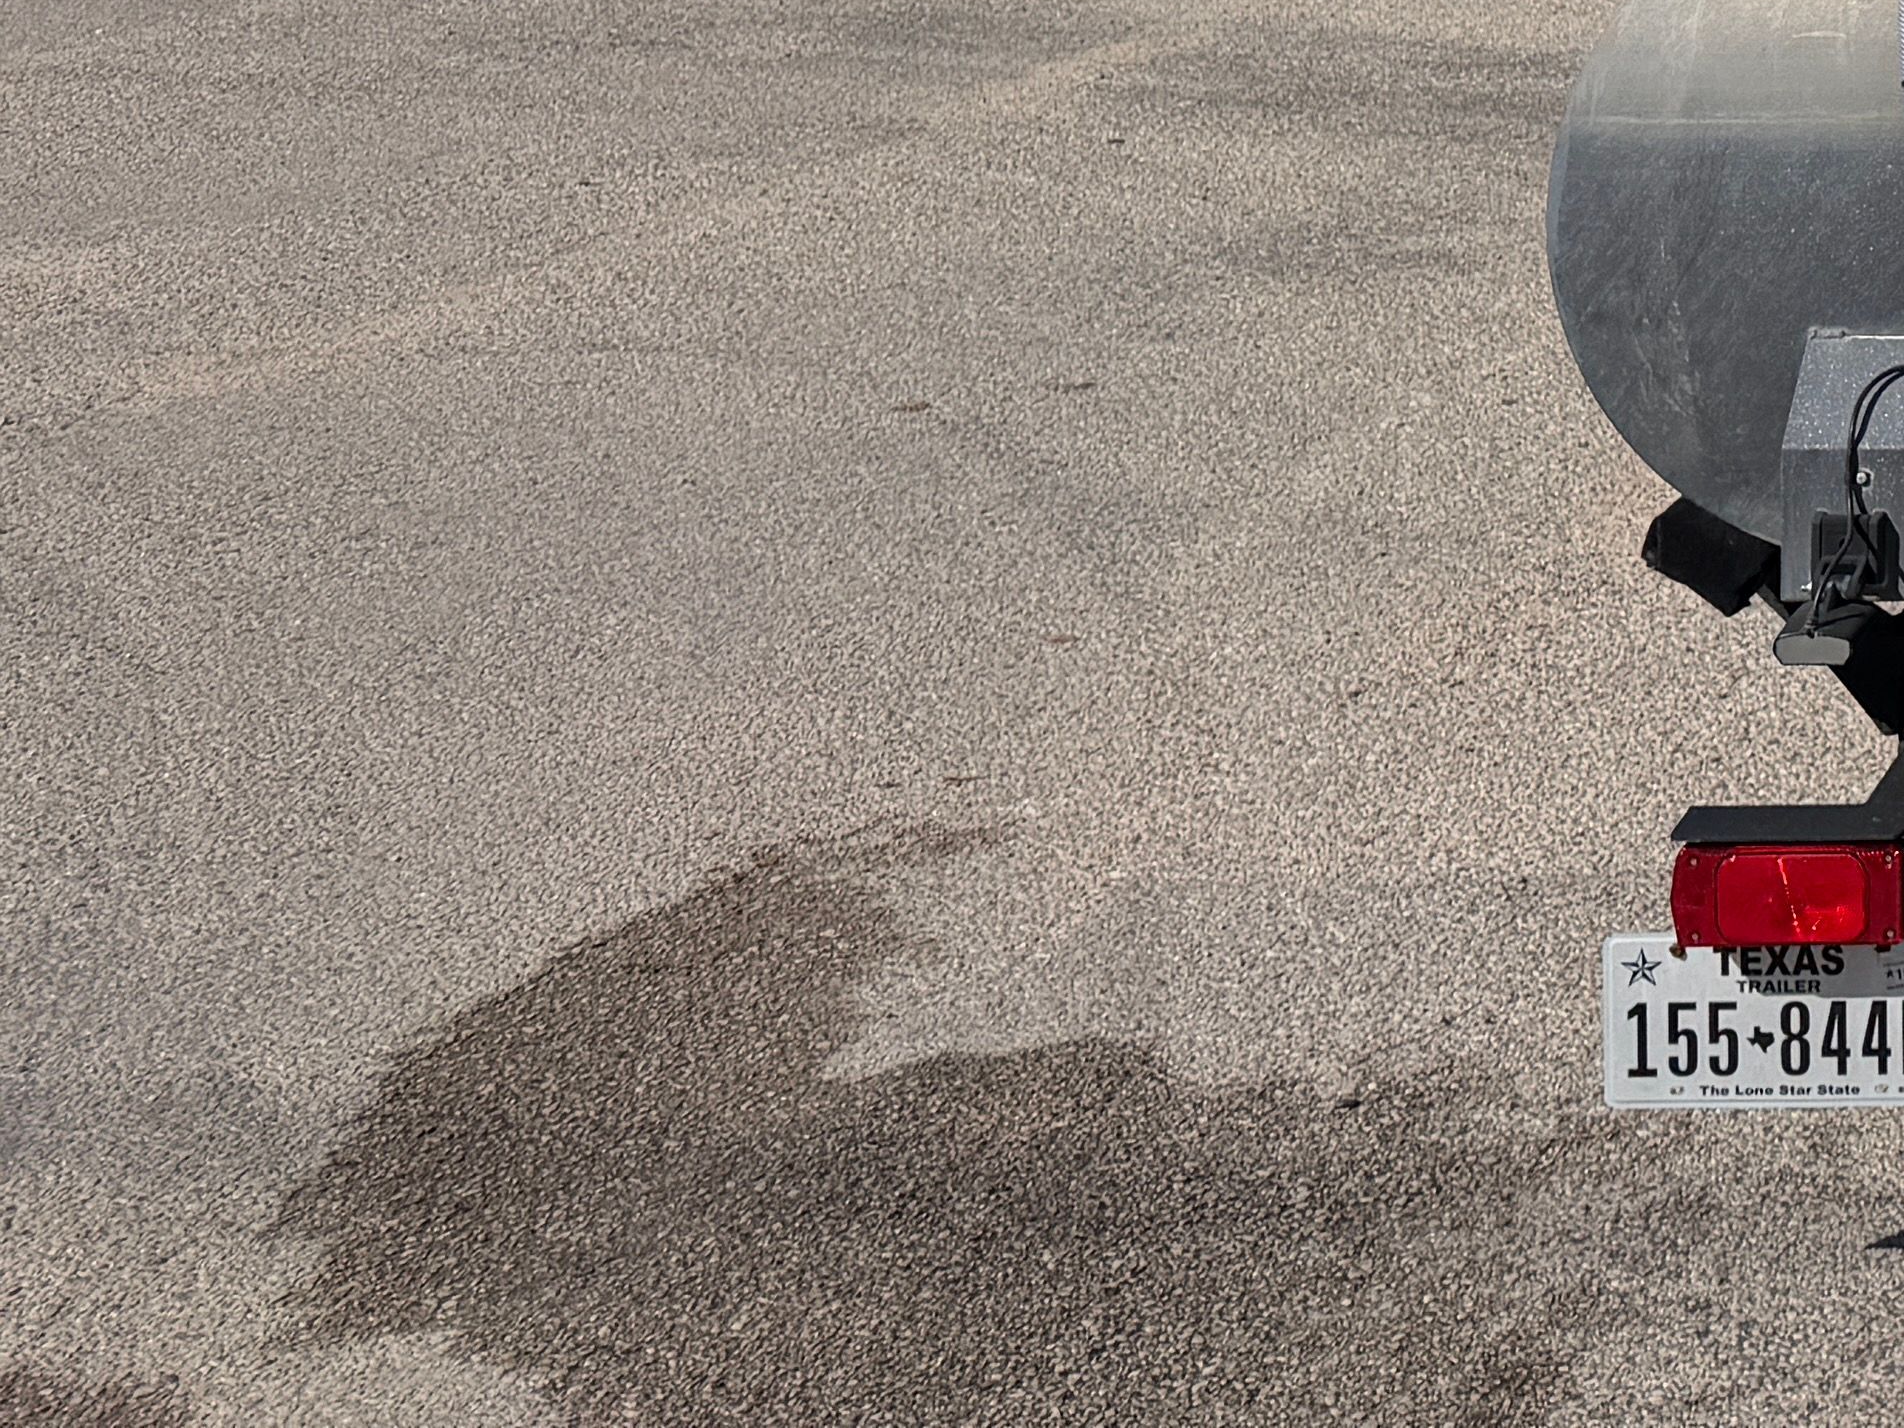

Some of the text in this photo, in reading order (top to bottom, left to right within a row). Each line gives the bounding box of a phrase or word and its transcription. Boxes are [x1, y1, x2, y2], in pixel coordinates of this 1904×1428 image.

[1712, 945, 1846, 977] TEXAS
[1737, 979, 1822, 993] TRAILER
[1700, 1083, 1861, 1095] The Lone Star State
